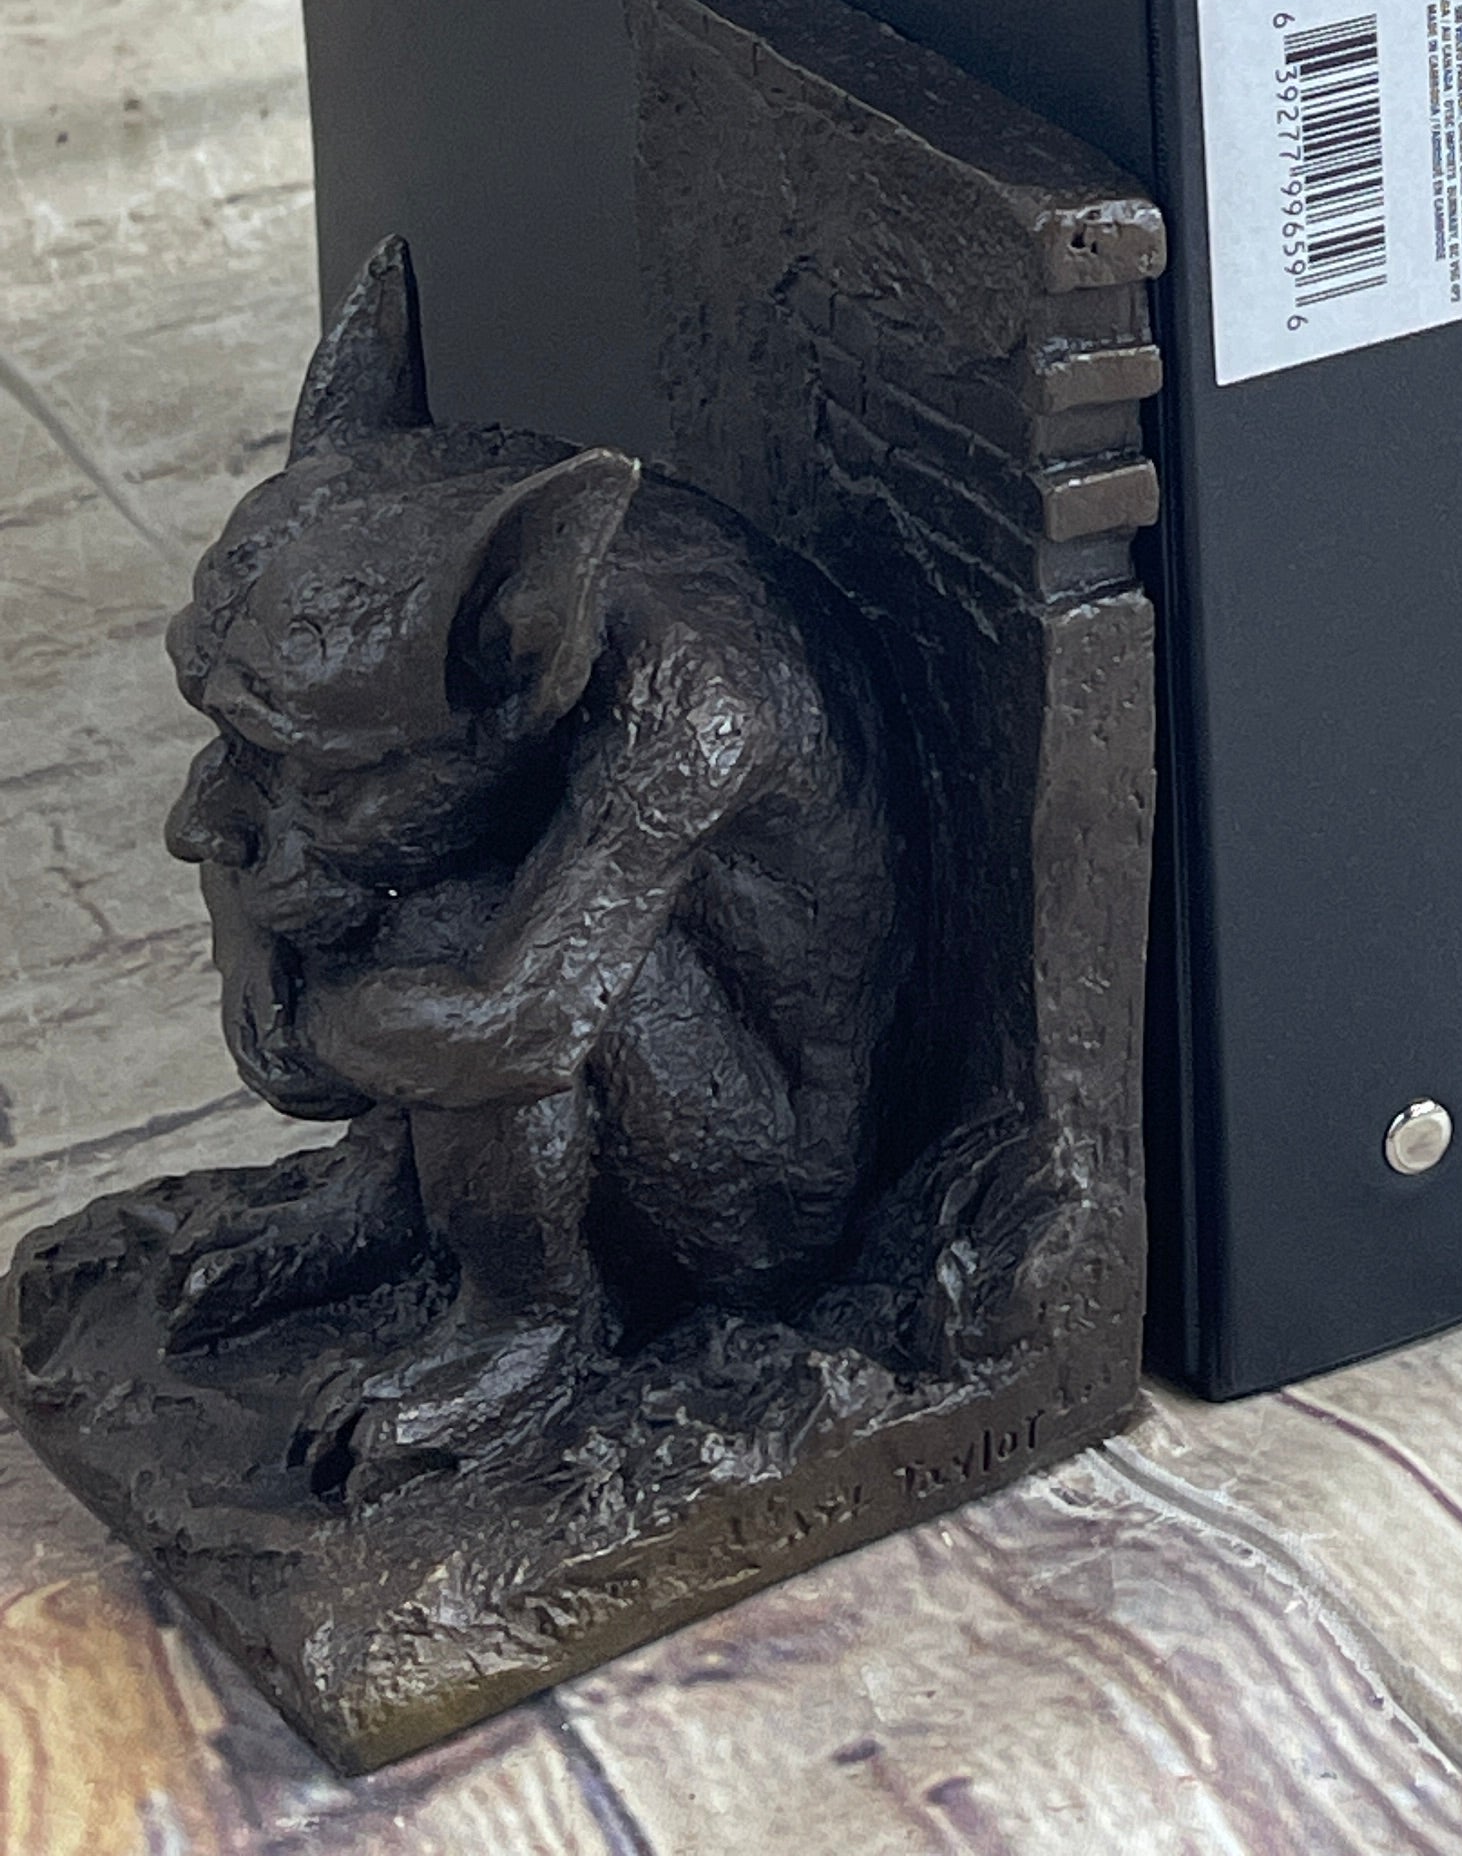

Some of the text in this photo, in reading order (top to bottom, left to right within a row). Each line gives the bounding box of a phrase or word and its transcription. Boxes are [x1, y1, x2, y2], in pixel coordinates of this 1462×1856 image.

[1271, 9, 1309, 332] 6 39277 99659 6
